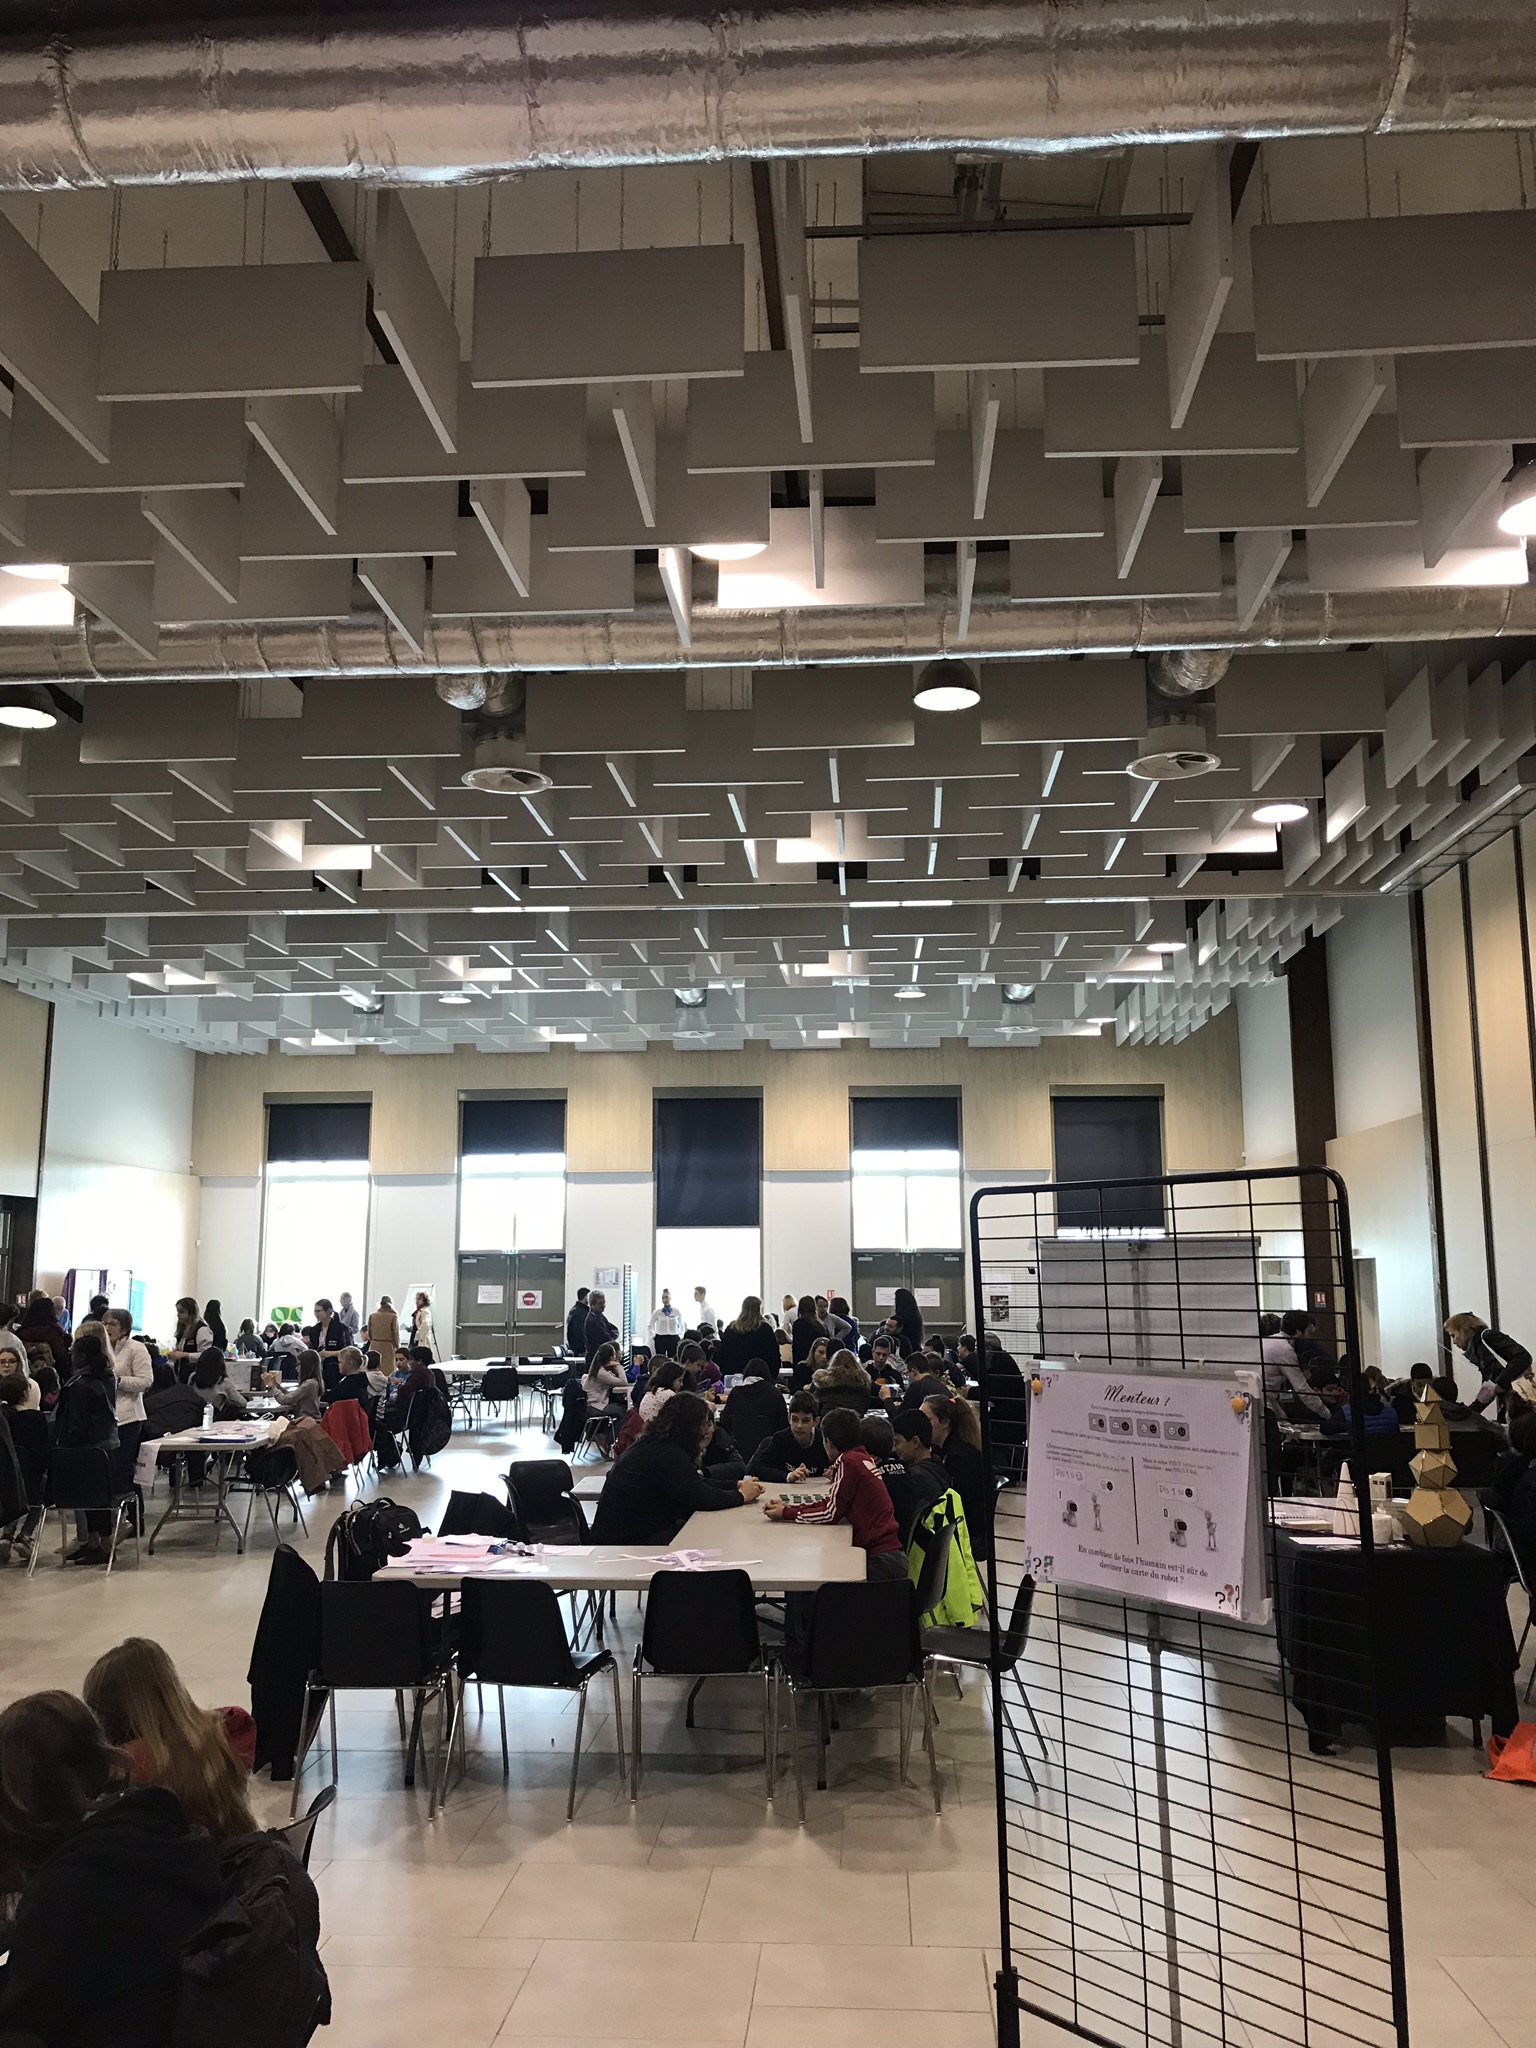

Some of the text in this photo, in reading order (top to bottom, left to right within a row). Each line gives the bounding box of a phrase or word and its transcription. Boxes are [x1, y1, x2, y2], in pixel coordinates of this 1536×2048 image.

[1104, 1384, 1171, 1407] Menteur !
[1078, 1544, 1208, 1578] En combien de fois l'humain est-il sûr de
[1099, 1560, 1184, 1584] deviner la carte du robot ?
